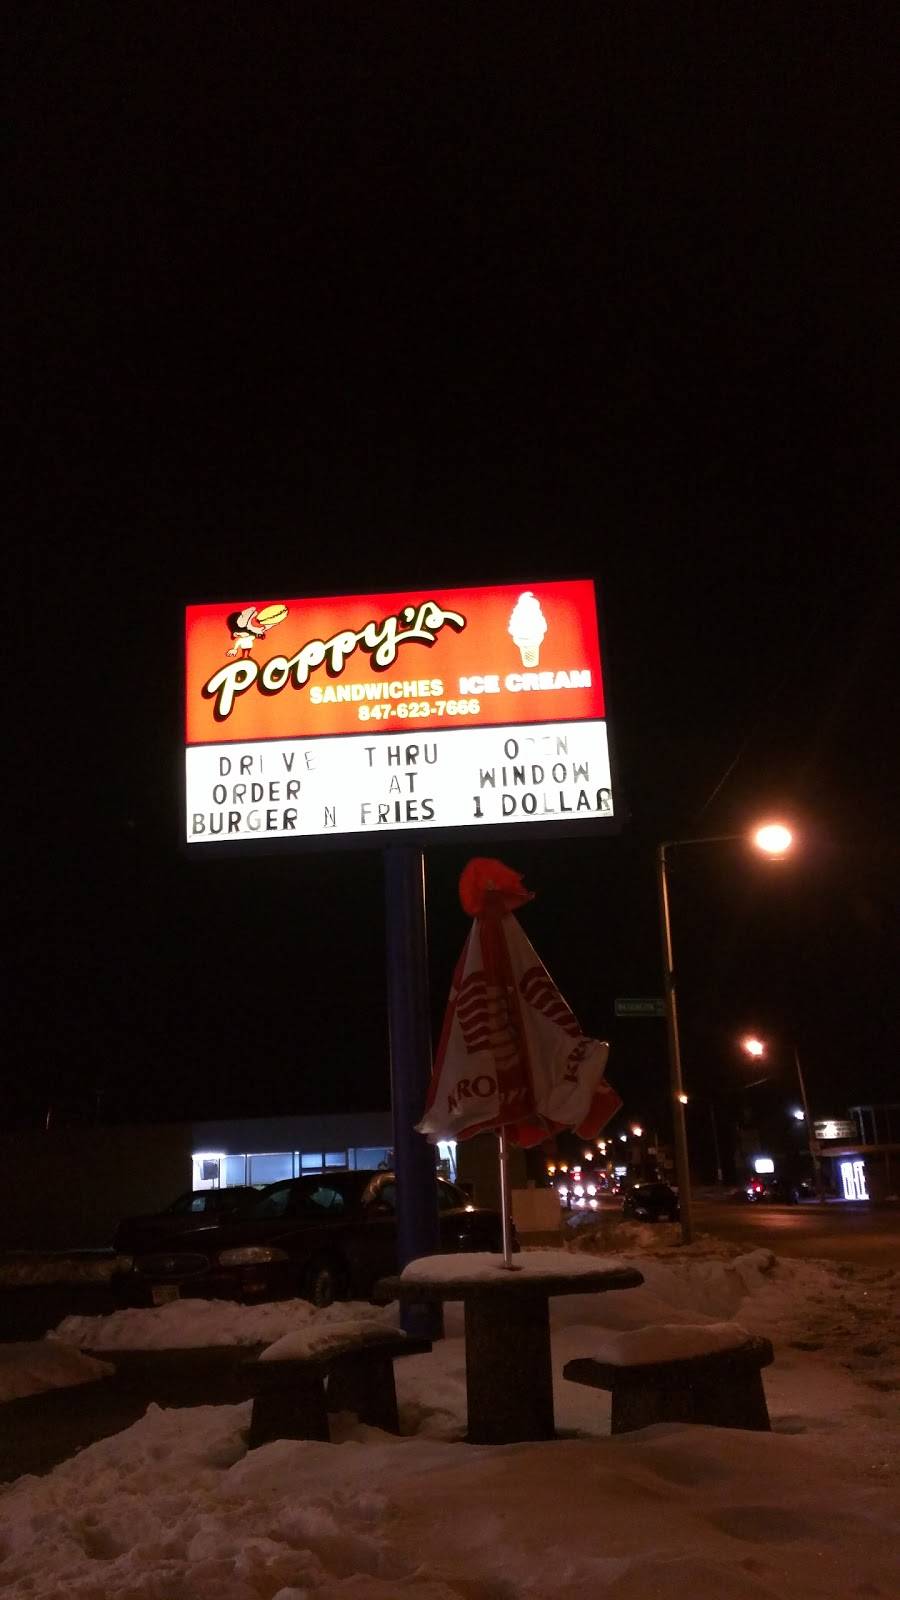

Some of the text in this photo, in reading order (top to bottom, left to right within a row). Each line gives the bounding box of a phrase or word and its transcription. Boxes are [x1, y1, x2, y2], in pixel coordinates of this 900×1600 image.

[309, 669, 592, 704] SANDWICHES ICE CREAM
[357, 699, 481, 722] 847-623-7666
[219, 735, 569, 776] DRIVE THRU ON
[212, 761, 590, 805] ORDER AT WINDOW
[192, 788, 613, 835] BURGER N FRIES 1 DOLLAR
